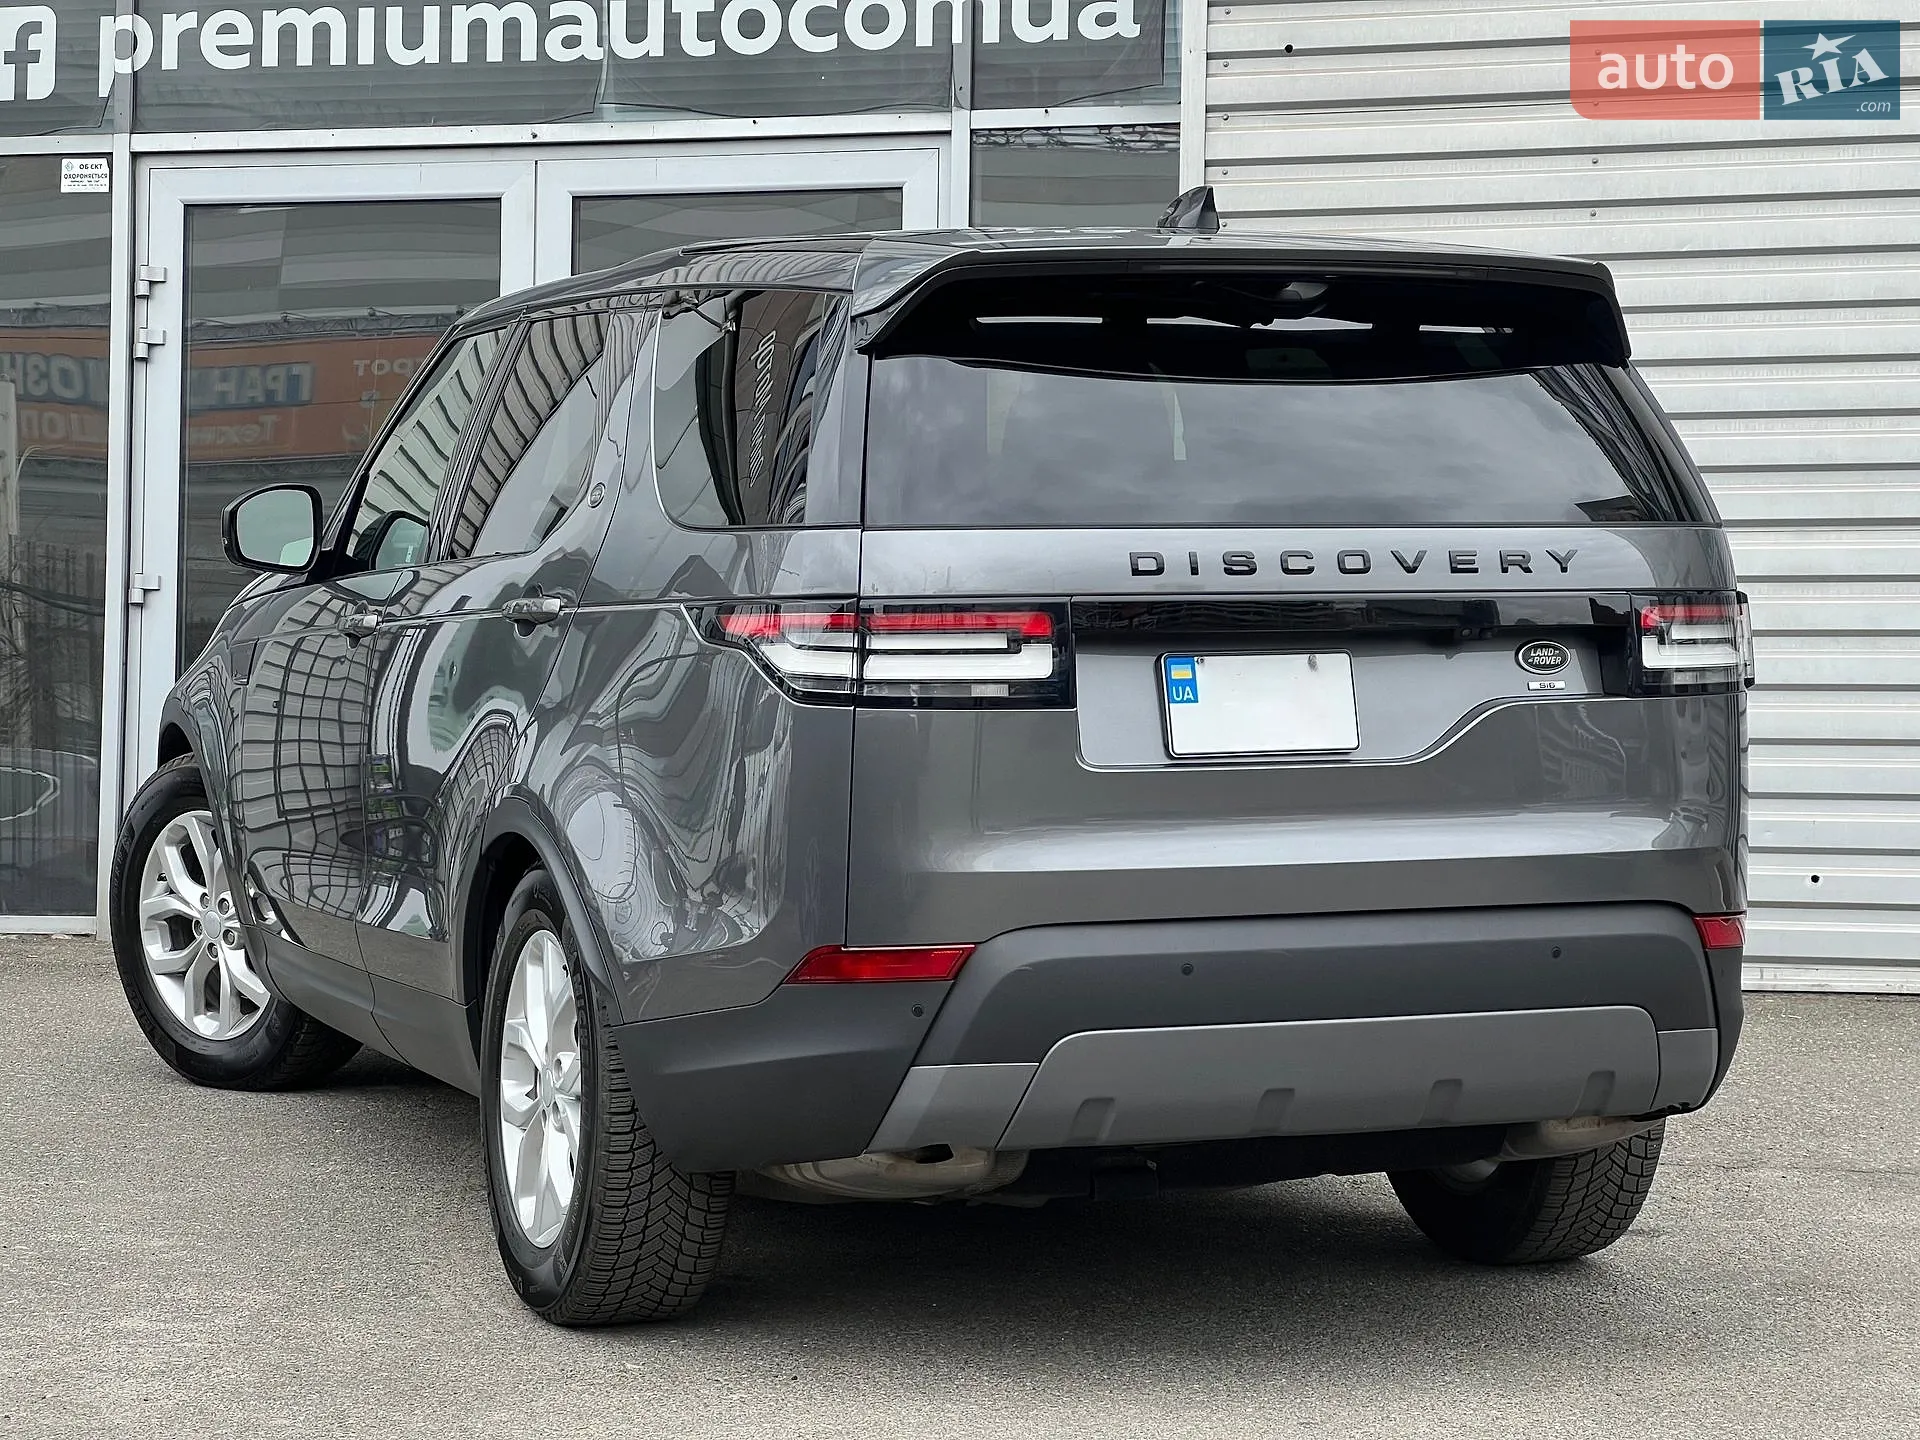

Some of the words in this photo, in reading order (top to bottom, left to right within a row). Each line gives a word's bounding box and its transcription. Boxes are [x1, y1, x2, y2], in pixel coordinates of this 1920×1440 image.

[1128, 548, 1579, 577] DISCOVERY
[1531, 647, 1555, 657] LAND
[1533, 656, 1562, 665] ROVER
[1172, 686, 1195, 701] UA
